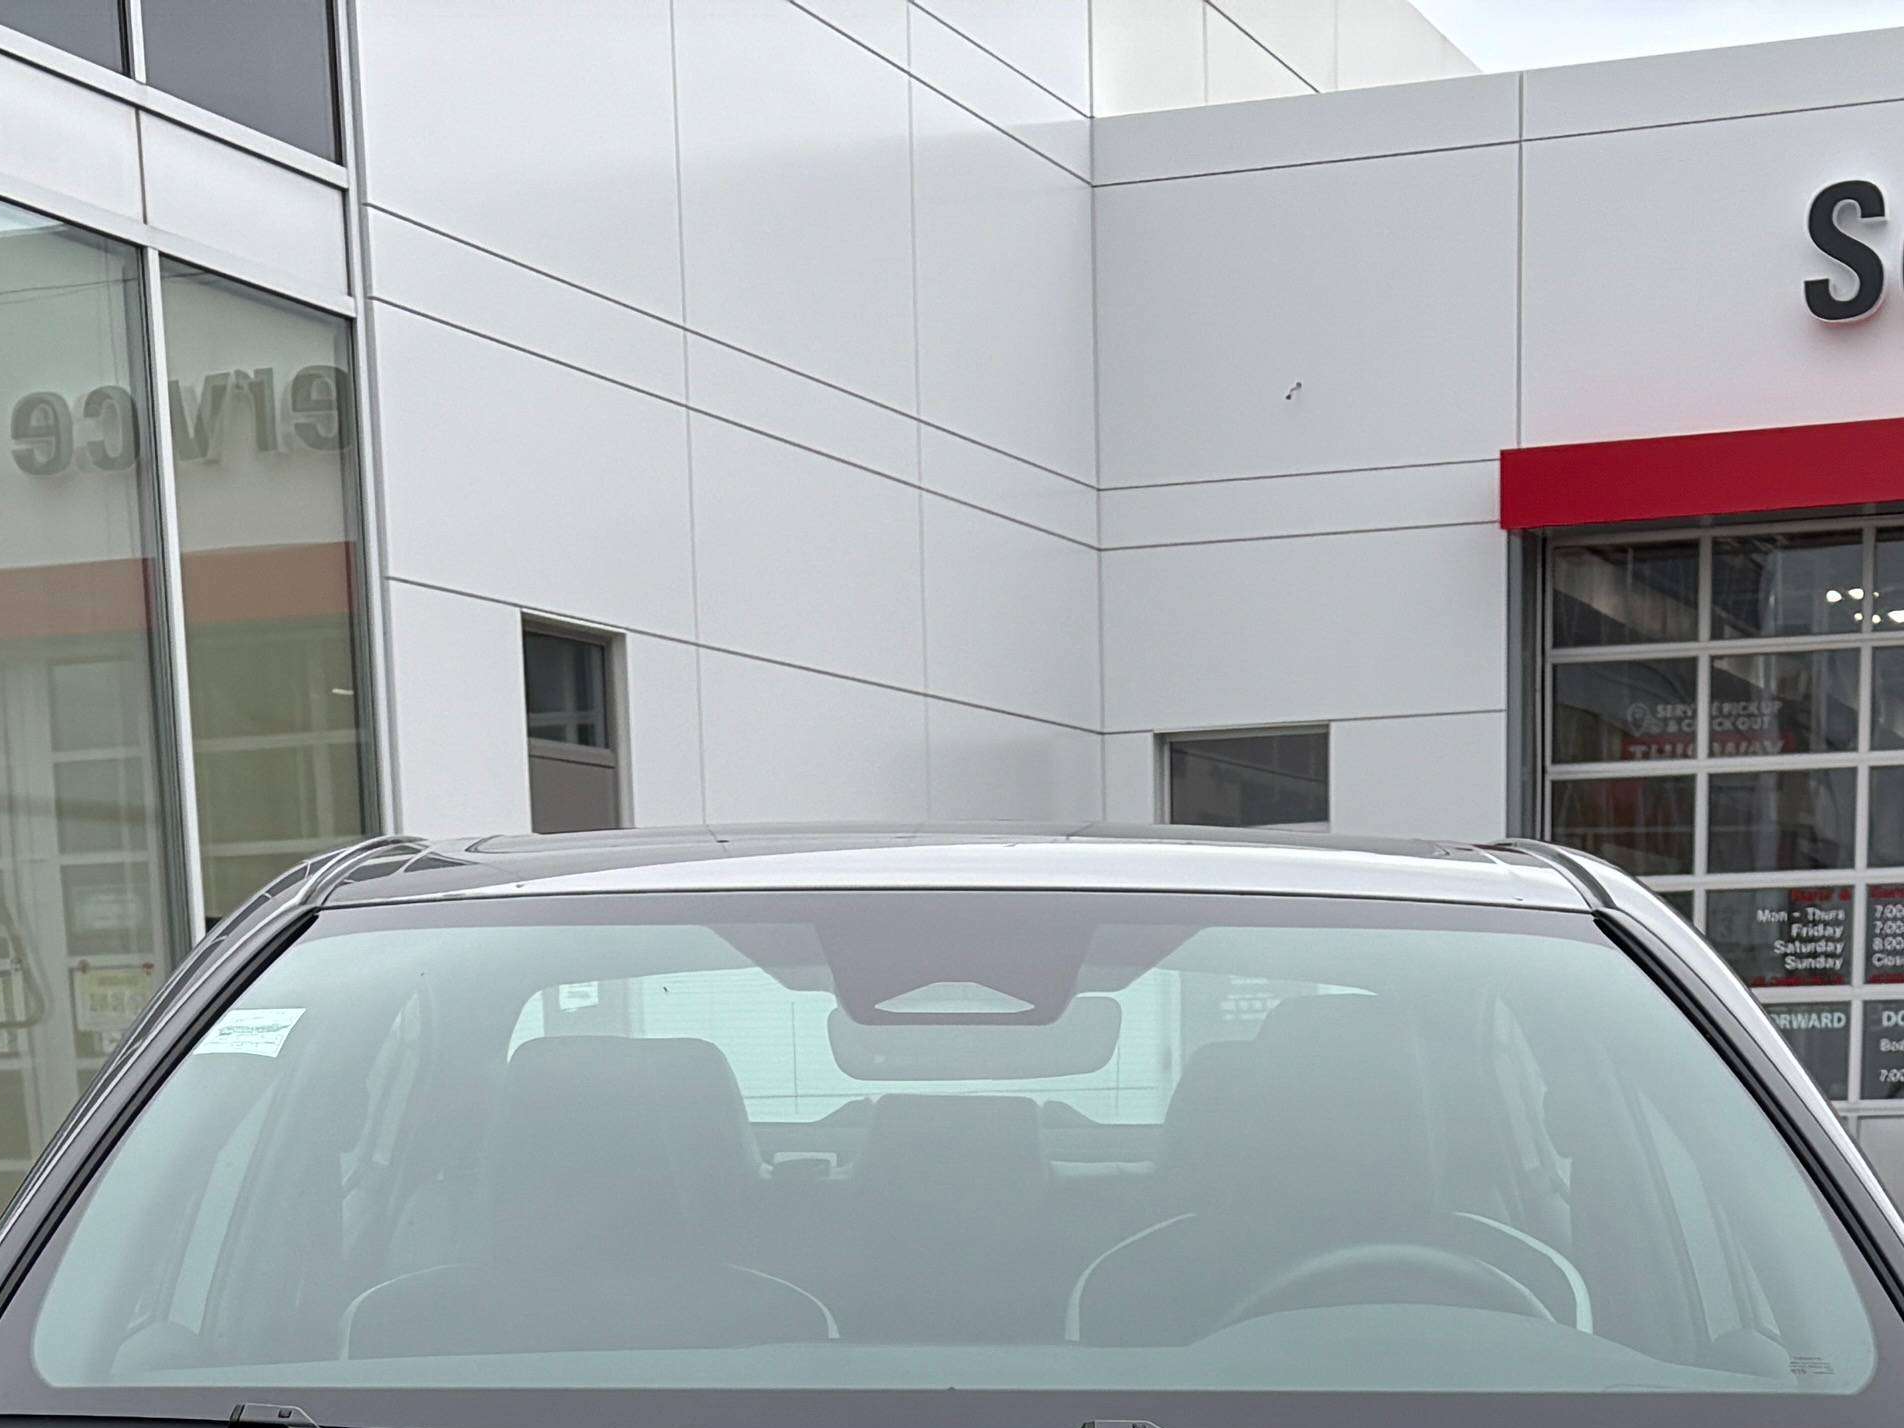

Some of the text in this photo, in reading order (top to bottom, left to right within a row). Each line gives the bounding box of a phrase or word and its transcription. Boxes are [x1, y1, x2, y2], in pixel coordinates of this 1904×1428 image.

[1656, 702, 1719, 718] SERVE
[1757, 908, 1788, 922] Mon
[1806, 906, 1845, 921] Thurs
[1791, 923, 1844, 938] Friday
[1774, 939, 1845, 955] Saturday
[1784, 955, 1844, 970] Sunday
